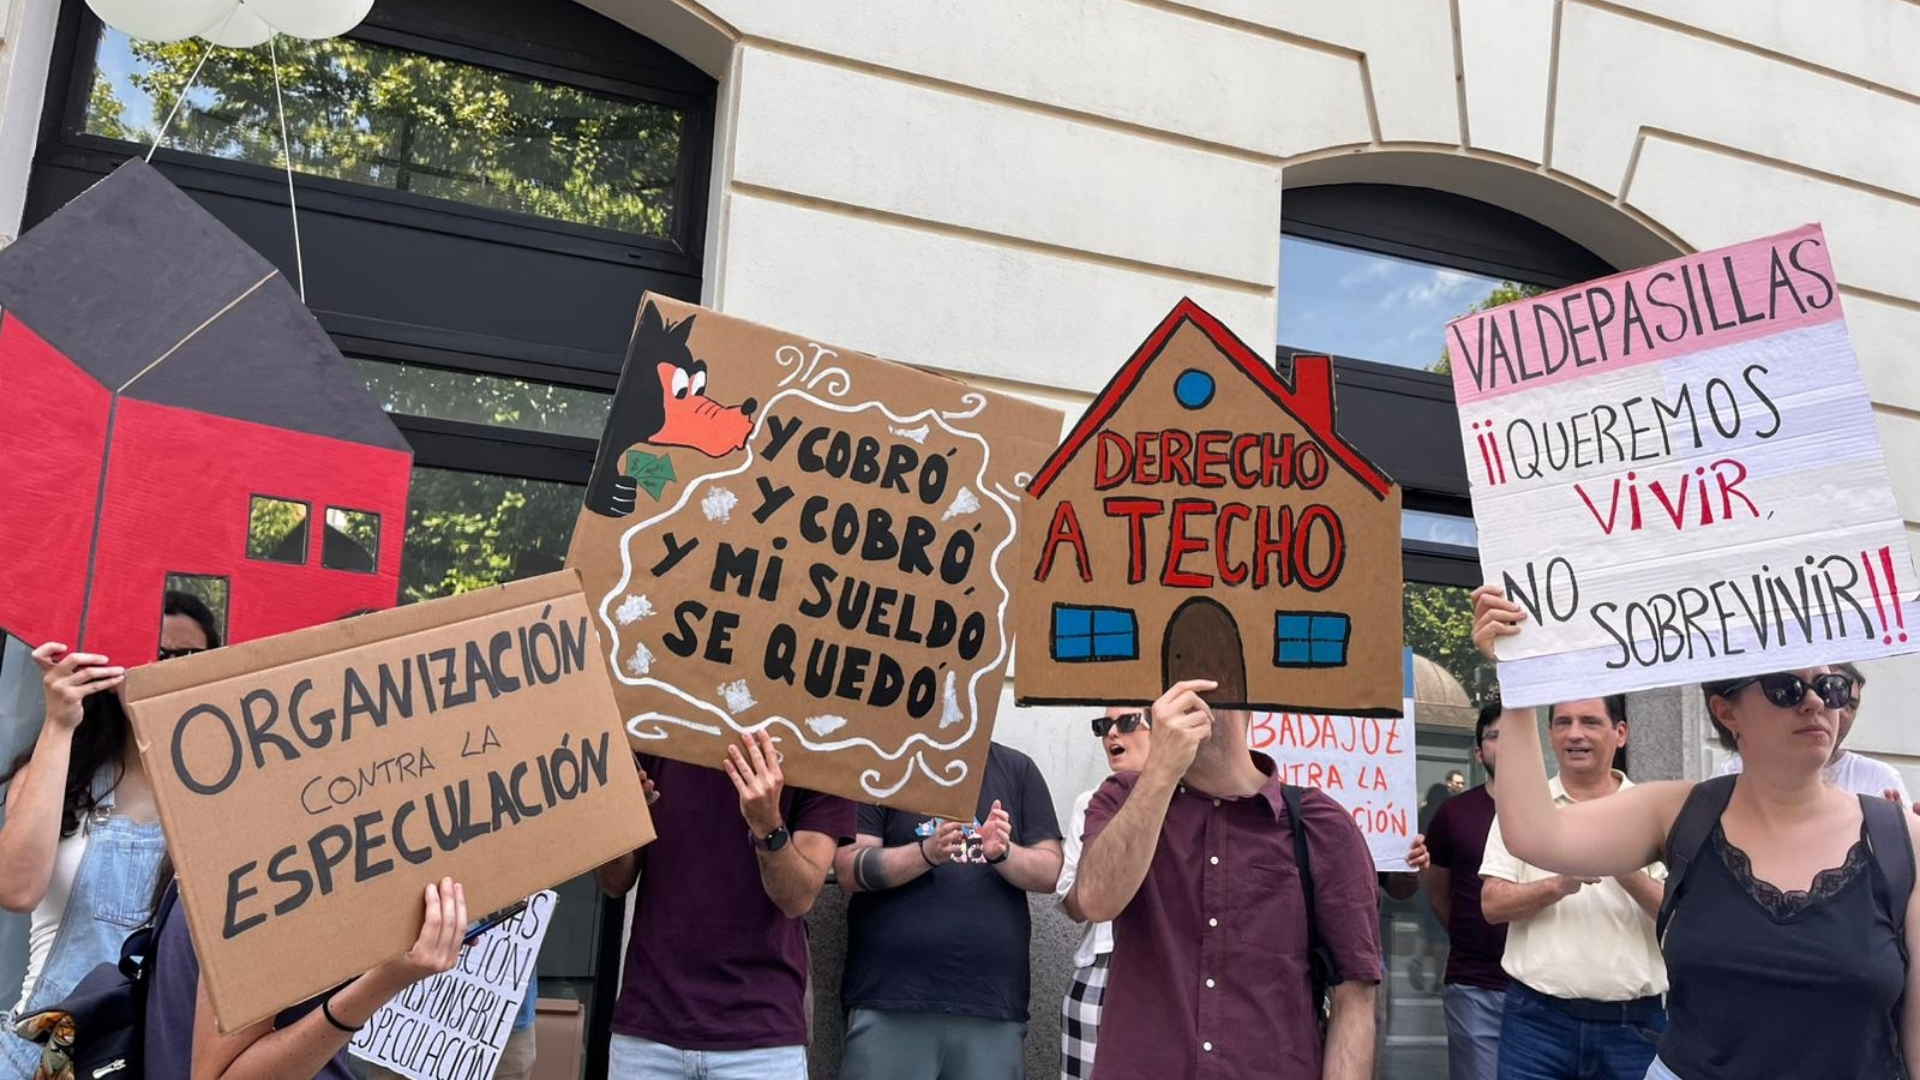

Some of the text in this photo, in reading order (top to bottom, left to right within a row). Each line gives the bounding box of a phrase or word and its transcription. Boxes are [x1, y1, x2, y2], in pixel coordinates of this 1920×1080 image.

[1451, 238, 1834, 393] VALDEPASILLAS
[751, 476, 795, 524] Y
[759, 415, 958, 504] Y COBRÓ
[1094, 428, 1329, 491] DERECHO
[650, 532, 699, 577] Y
[1033, 497, 1346, 592] A TECHO
[1502, 556, 1579, 627] NO
[171, 605, 588, 795] ORGANIZACIÓN
[662, 601, 948, 719] SE QUEDÓ
[300, 724, 502, 815] CONTRA LA
[1250, 711, 1403, 756] BADAJOZ
[1357, 766, 1388, 791] LA
[222, 732, 610, 940] ESPECULACIÓN
[350, 1007, 497, 1080] SPECULACIÓN
